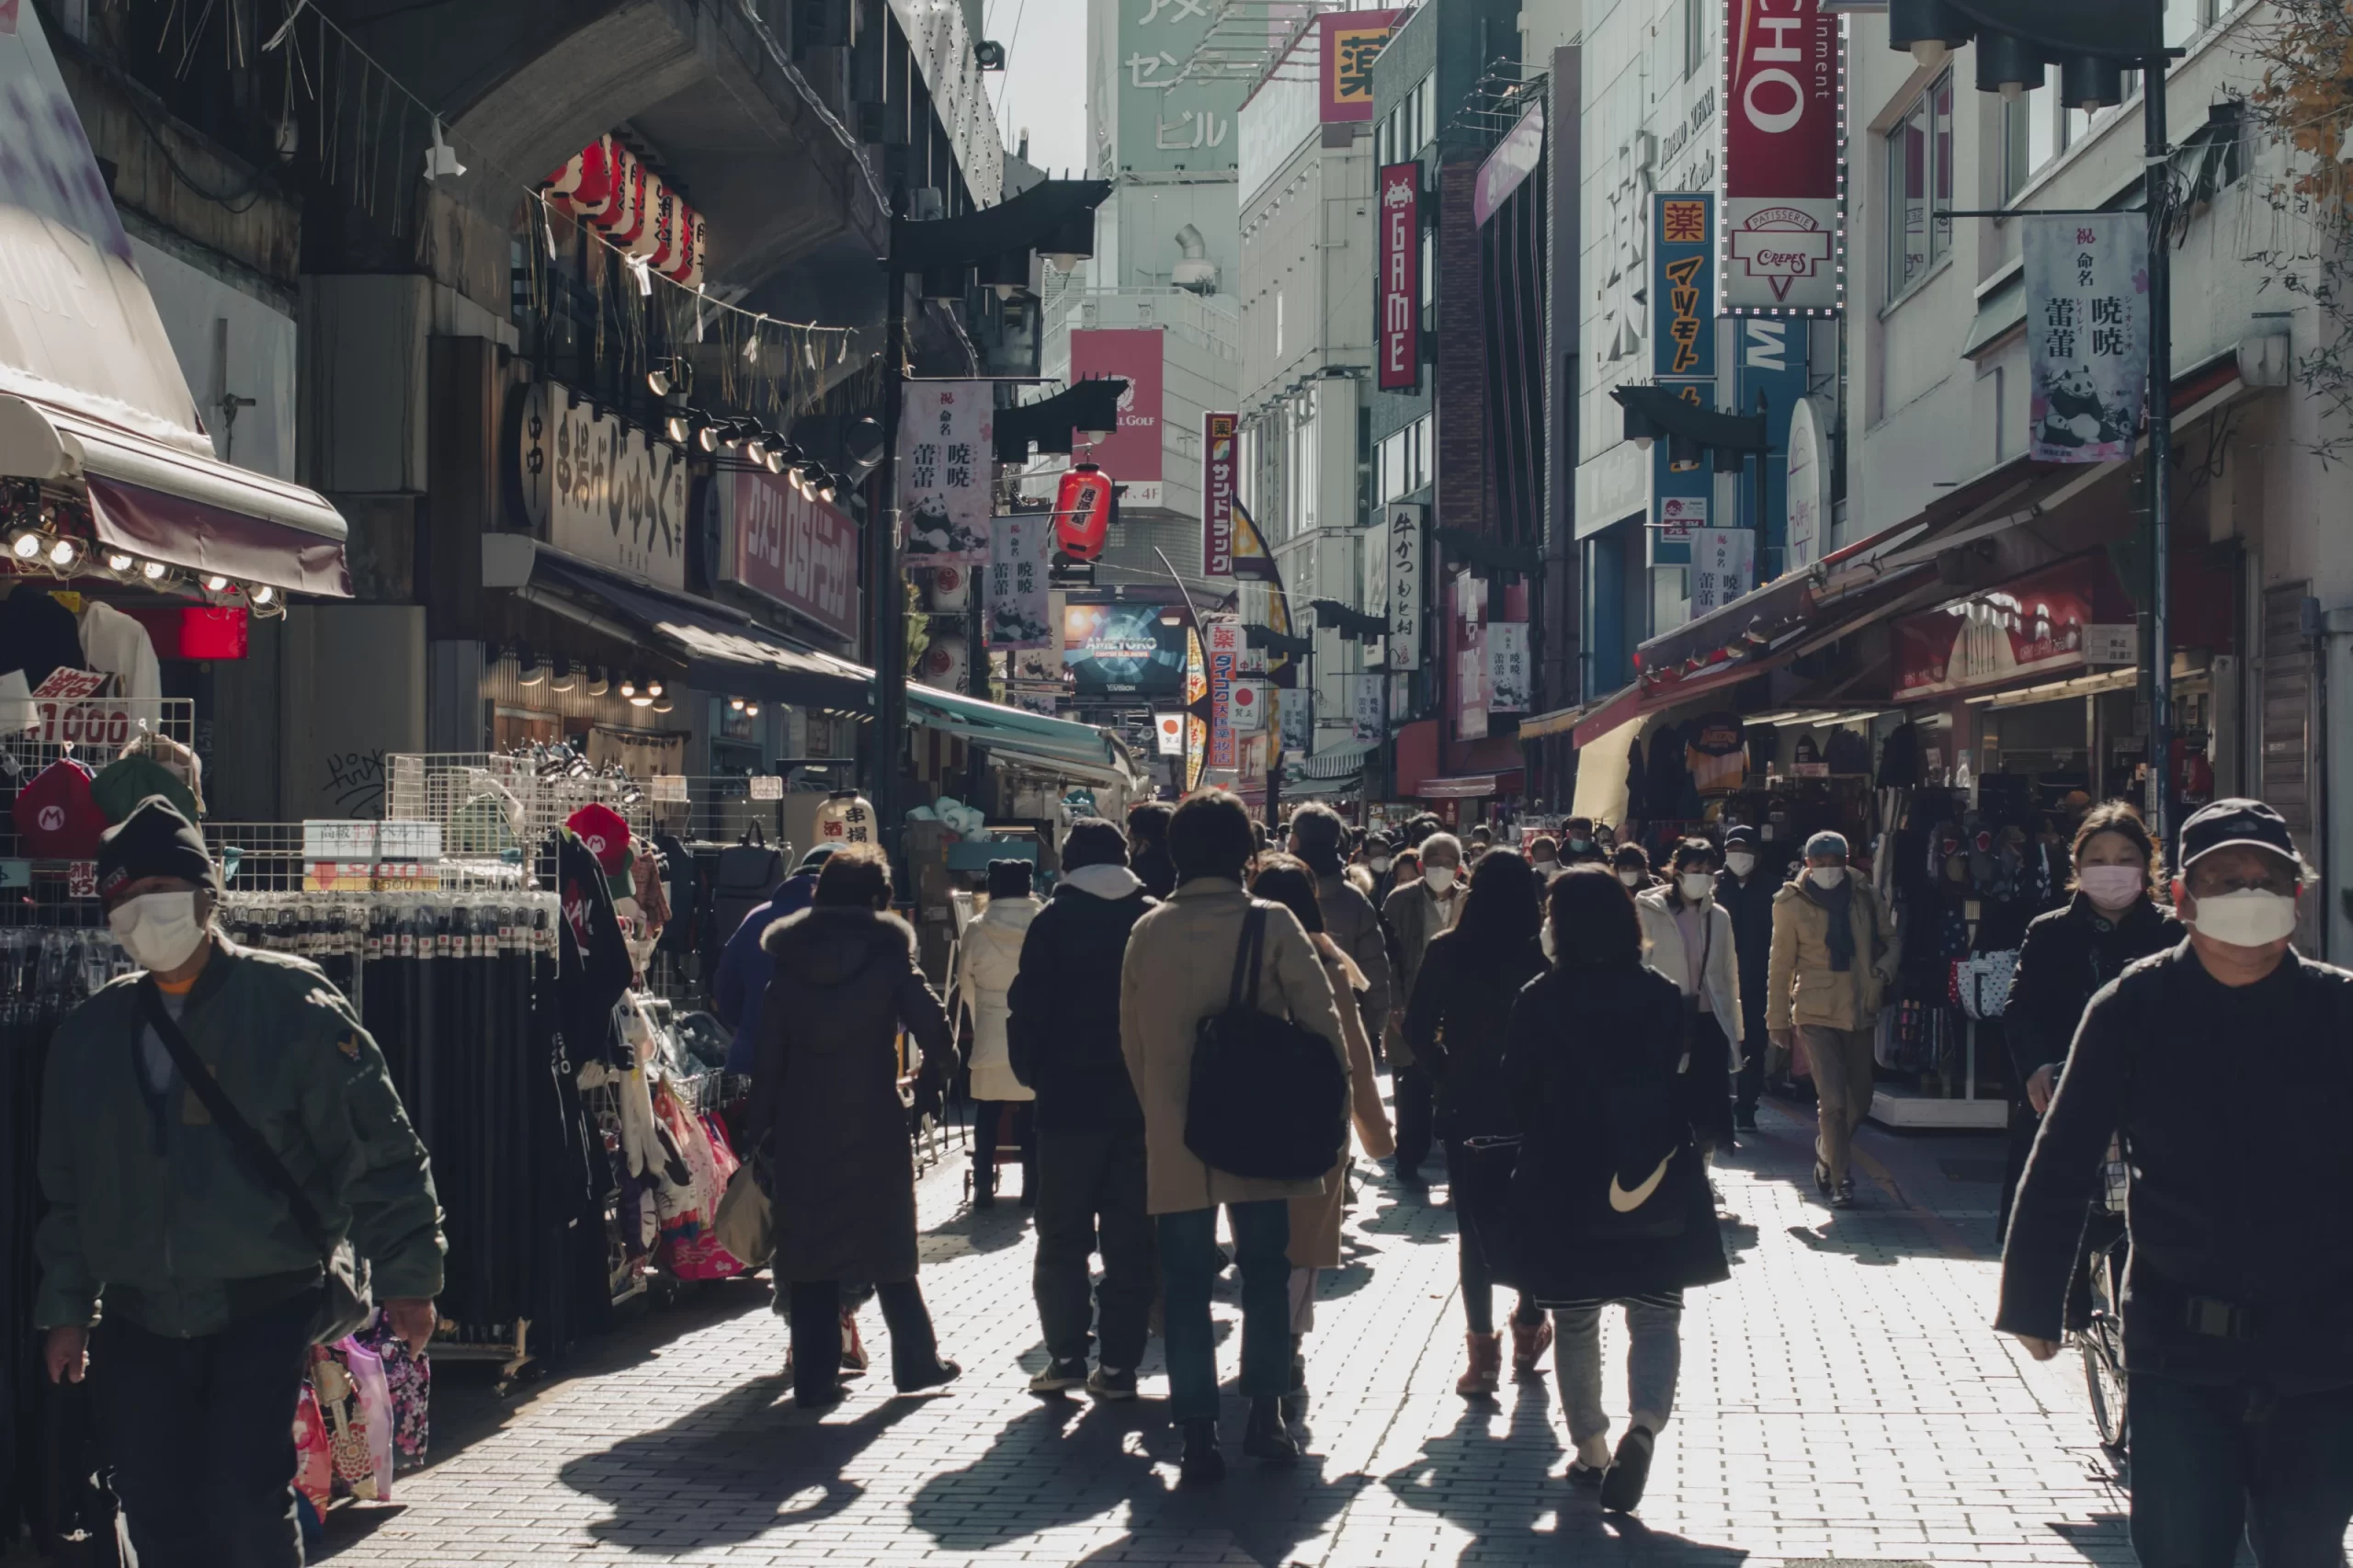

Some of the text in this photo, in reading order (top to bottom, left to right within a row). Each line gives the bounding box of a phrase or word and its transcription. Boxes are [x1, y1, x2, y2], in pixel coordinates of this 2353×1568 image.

[1744, 0, 1804, 133] HO
[1156, 110, 1228, 149] ビル
[1666, 203, 1703, 240] 薬
[1752, 210, 1811, 227] PATISSERIE
[2075, 228, 2096, 244] 祝
[1756, 249, 1806, 274] CREPES
[2076, 252, 2094, 287] 命名
[1387, 211, 1409, 372] GAME
[2044, 297, 2075, 358] 蕾蕾
[2091, 296, 2123, 357] 暁暁
[939, 410, 952, 437] 命名
[1126, 415, 1155, 426] GOLF
[1213, 419, 1231, 437] 薬
[747, 473, 782, 570] クスリ
[1212, 463, 1231, 572] サンドラッグ
[1086, 636, 1158, 651] AMEYOKO
[1213, 627, 1234, 649] 薬
[1213, 654, 1233, 703] ダイコク
[1234, 708, 1254, 718] 賀正
[824, 821, 843, 836] 酒
[71, 879, 98, 895] ¥5
